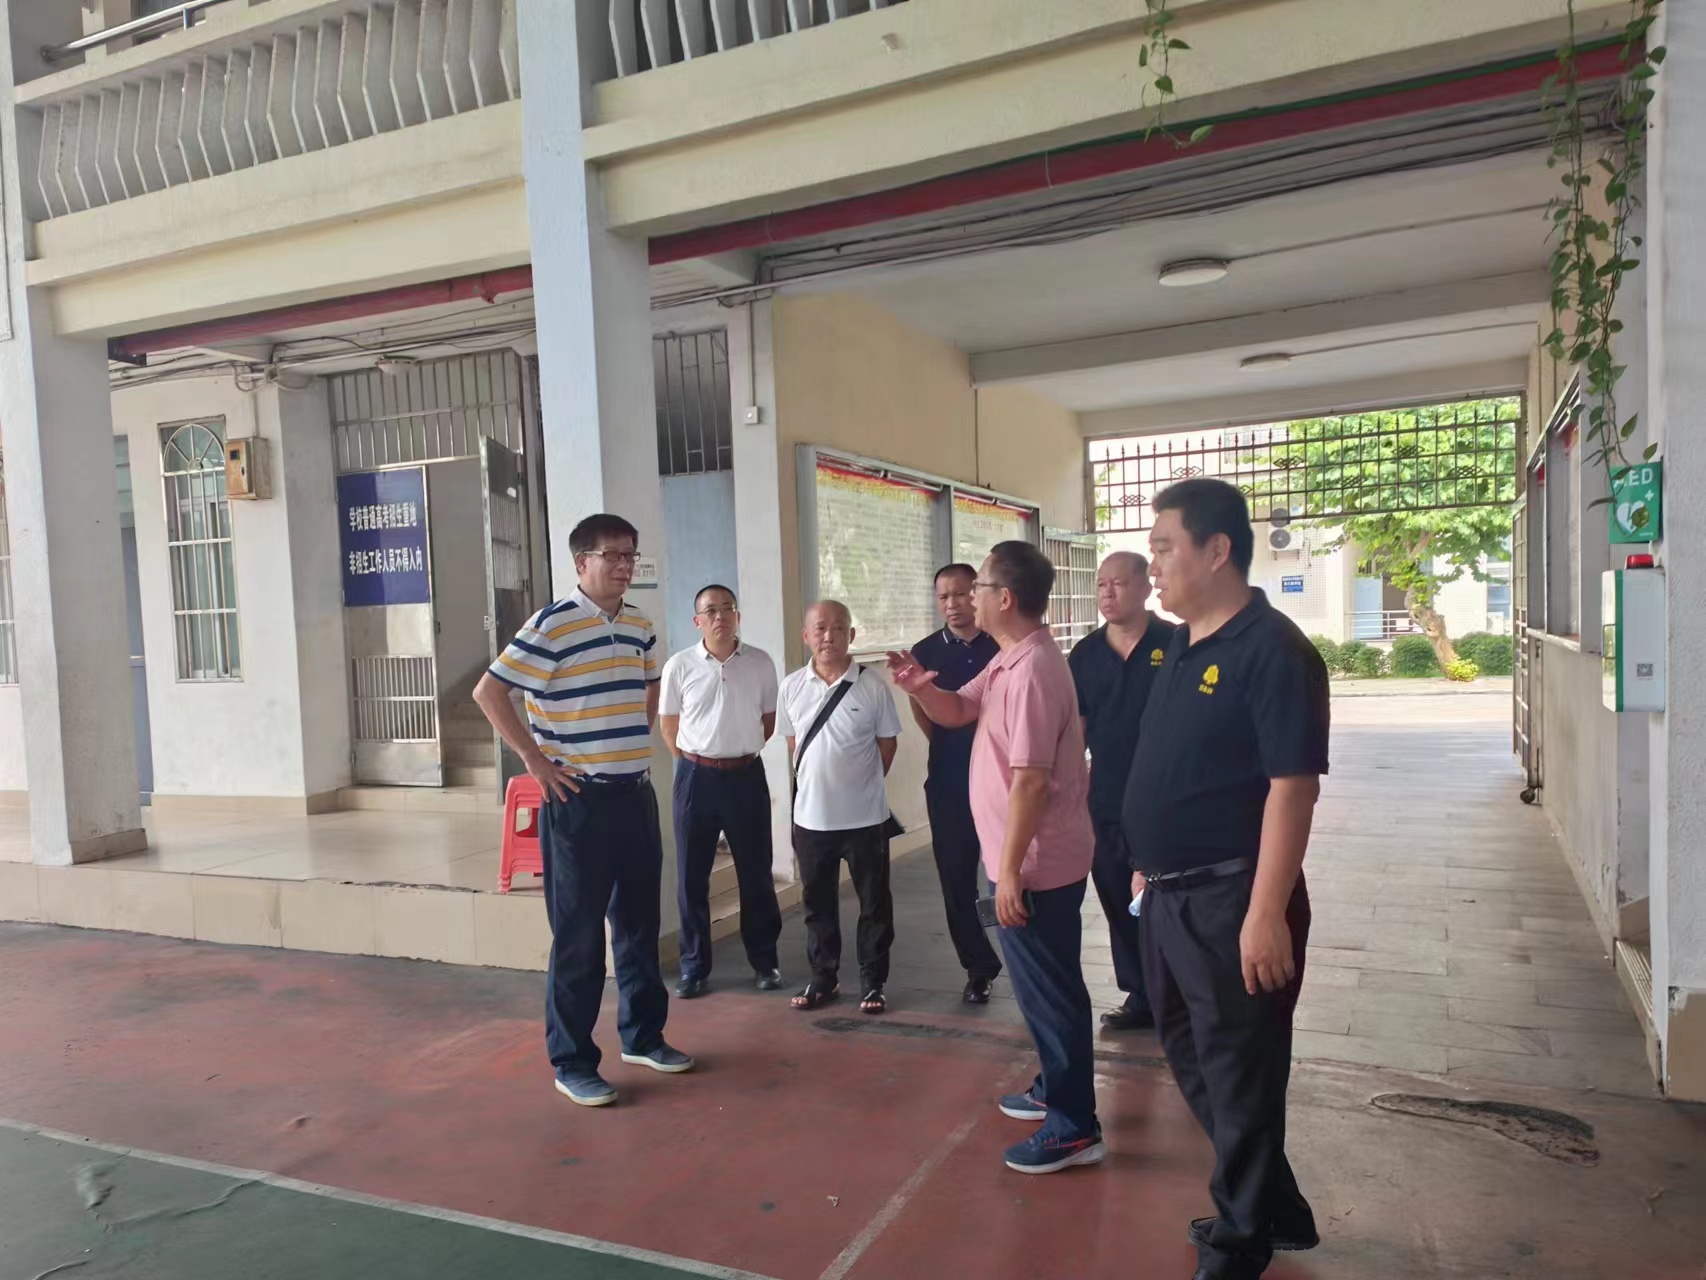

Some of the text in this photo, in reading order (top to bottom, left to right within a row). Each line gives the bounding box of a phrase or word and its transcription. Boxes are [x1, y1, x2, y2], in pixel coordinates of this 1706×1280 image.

[350, 501, 417, 532] 学校普通高考招生重地
[348, 545, 423, 575] 非招生工作人员不得入内
